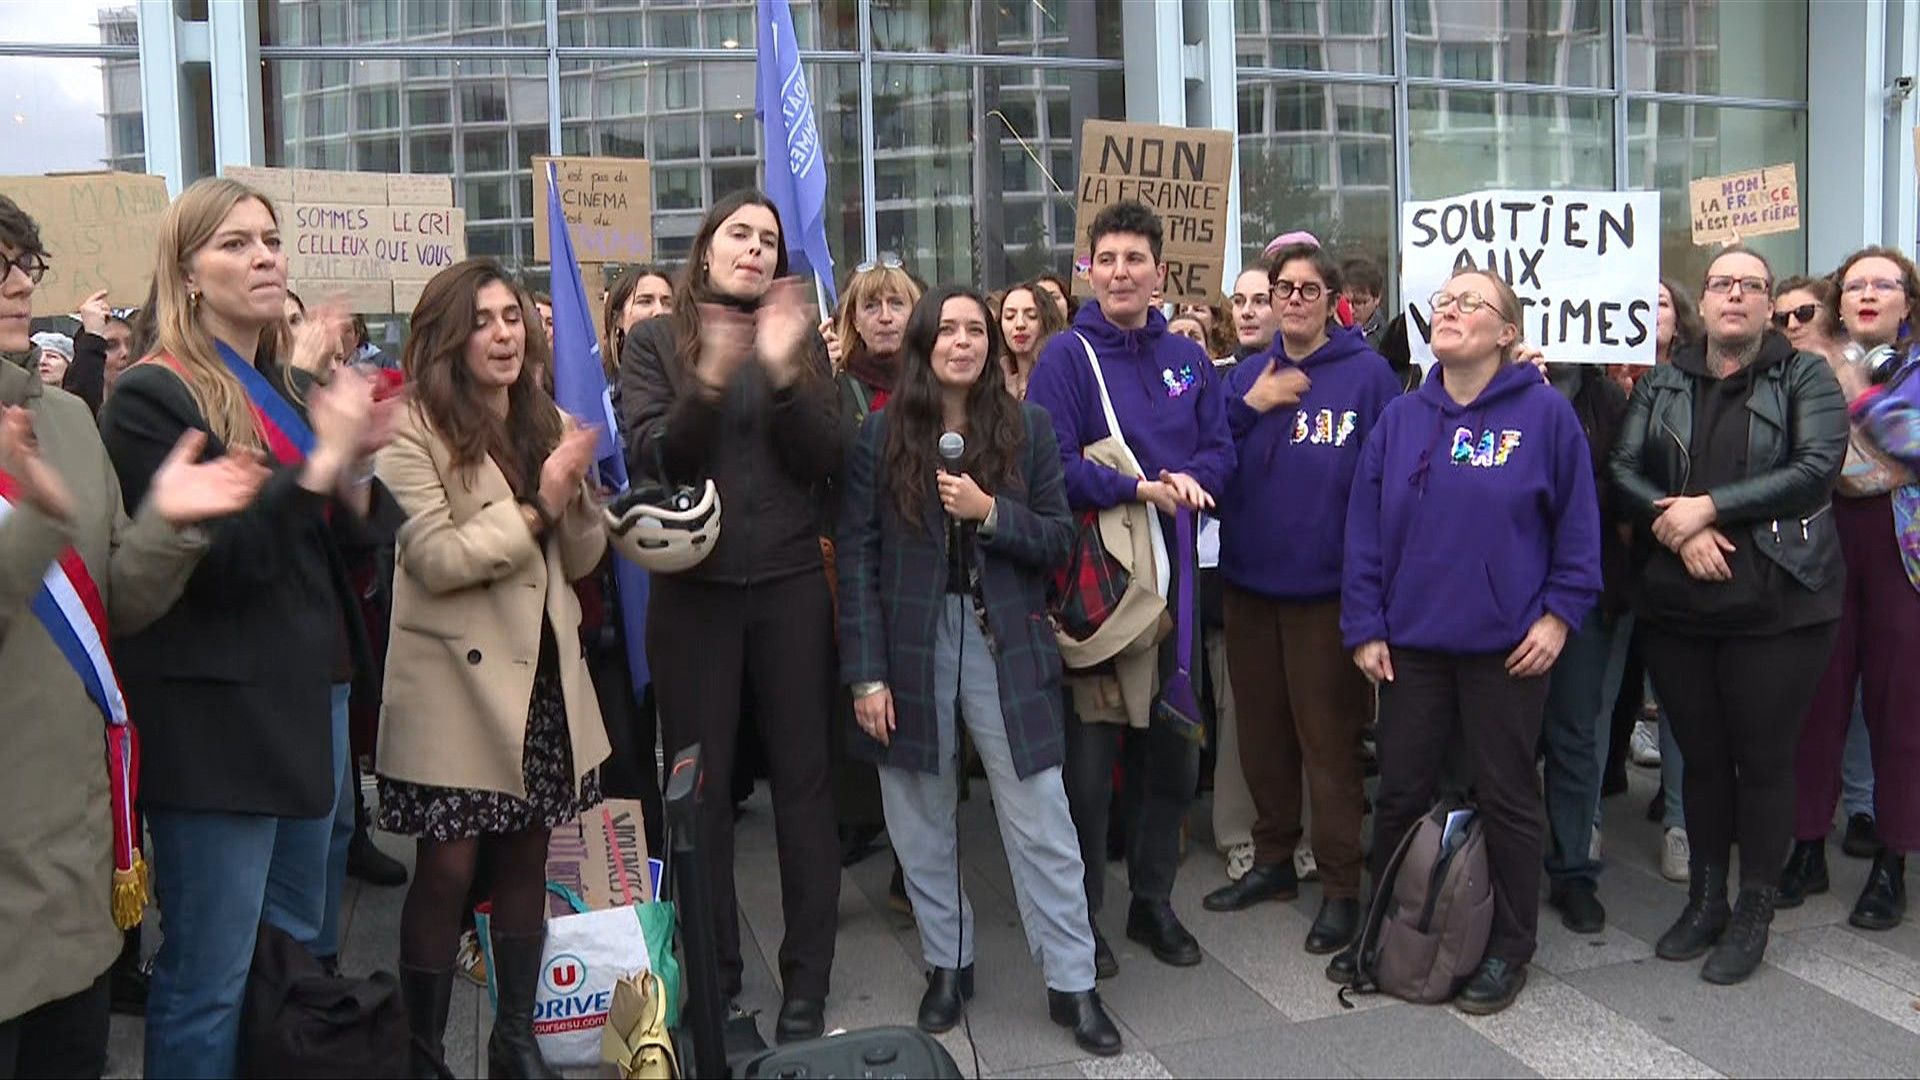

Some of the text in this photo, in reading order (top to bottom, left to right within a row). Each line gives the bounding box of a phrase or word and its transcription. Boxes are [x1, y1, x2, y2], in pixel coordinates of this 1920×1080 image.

[1100, 135, 1206, 182] NON
[614, 169, 629, 184] du
[562, 188, 628, 211] CINEMA
[1082, 176, 1220, 211] LA FRANCE
[1700, 186, 1790, 215] LA FRANCE
[297, 208, 368, 230] SOMMES
[393, 211, 413, 233] LE
[593, 213, 612, 227] du
[1167, 214, 1214, 244] PAS
[1732, 211, 1758, 227] PAS
[297, 234, 453, 267] CELLEUX QUE VOUS
[553, 964, 577, 987] U
[534, 1015, 606, 1033] oursesu.com
